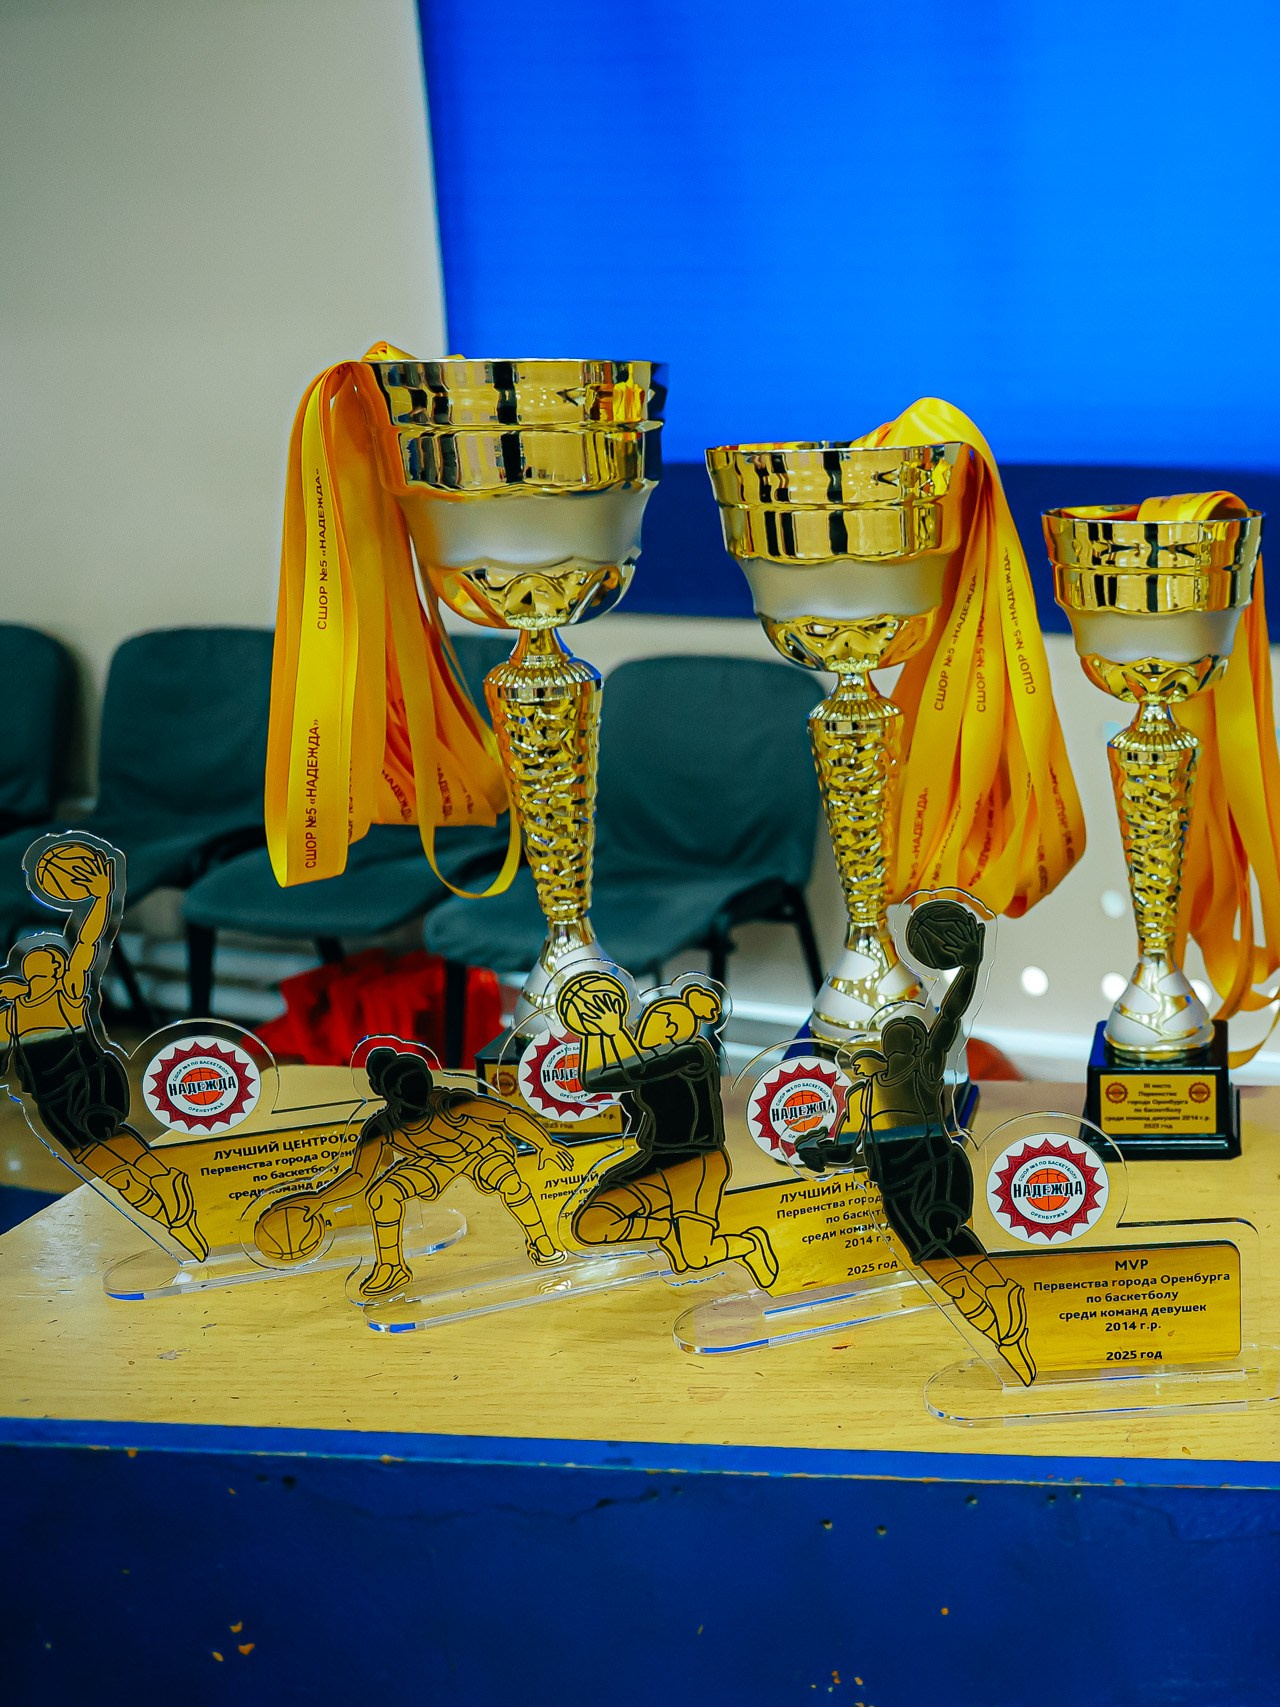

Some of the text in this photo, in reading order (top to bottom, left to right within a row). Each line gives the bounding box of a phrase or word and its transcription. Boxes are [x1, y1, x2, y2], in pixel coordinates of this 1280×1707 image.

[314, 468, 328, 630] СШОР №5 «НАДЕЖДА»
[1013, 629, 1025, 650] №5
[976, 648, 985, 667] №5
[934, 671, 949, 711] СШОР
[943, 648, 955, 667] №5
[1018, 654, 1036, 695] СШОР
[976, 672, 986, 712] СШОР
[305, 718, 321, 869] СШОР №5 «НАДЕЖДА»
[542, 1069, 578, 1083] НАДЕ
[168, 1076, 237, 1096] НАДЕЖДА
[213, 1133, 359, 1161] ЛУЧШИЙ ЦЕНТРОВО
[200, 1155, 318, 1176] Первенства города
[1018, 1168, 1029, 1182] СШОР
[1048, 1160, 1077, 1179] БАСКЕТБОЛУ
[252, 1173, 268, 1183] по
[780, 1182, 841, 1204] ЛУЧШИЙ
[1013, 1181, 1083, 1198] НАДЕЖДА
[777, 1200, 846, 1219] Первенства
[1030, 1209, 1068, 1220] ОРЕНБУРЖЬЕ
[826, 1215, 841, 1224] по
[801, 1230, 837, 1244] среди
[845, 1236, 873, 1248] 2014
[847, 1259, 898, 1276] 2025 год
[1115, 1259, 1149, 1271] MVP
[1033, 1272, 1230, 1293] Первенства города Оренбурга
[1086, 1289, 1179, 1304] по баскетболу
[1059, 1303, 1207, 1322] среди команд девушек
[1105, 1322, 1162, 1334] 2014 г.р.
[1106, 1350, 1163, 1361] 2025 год
